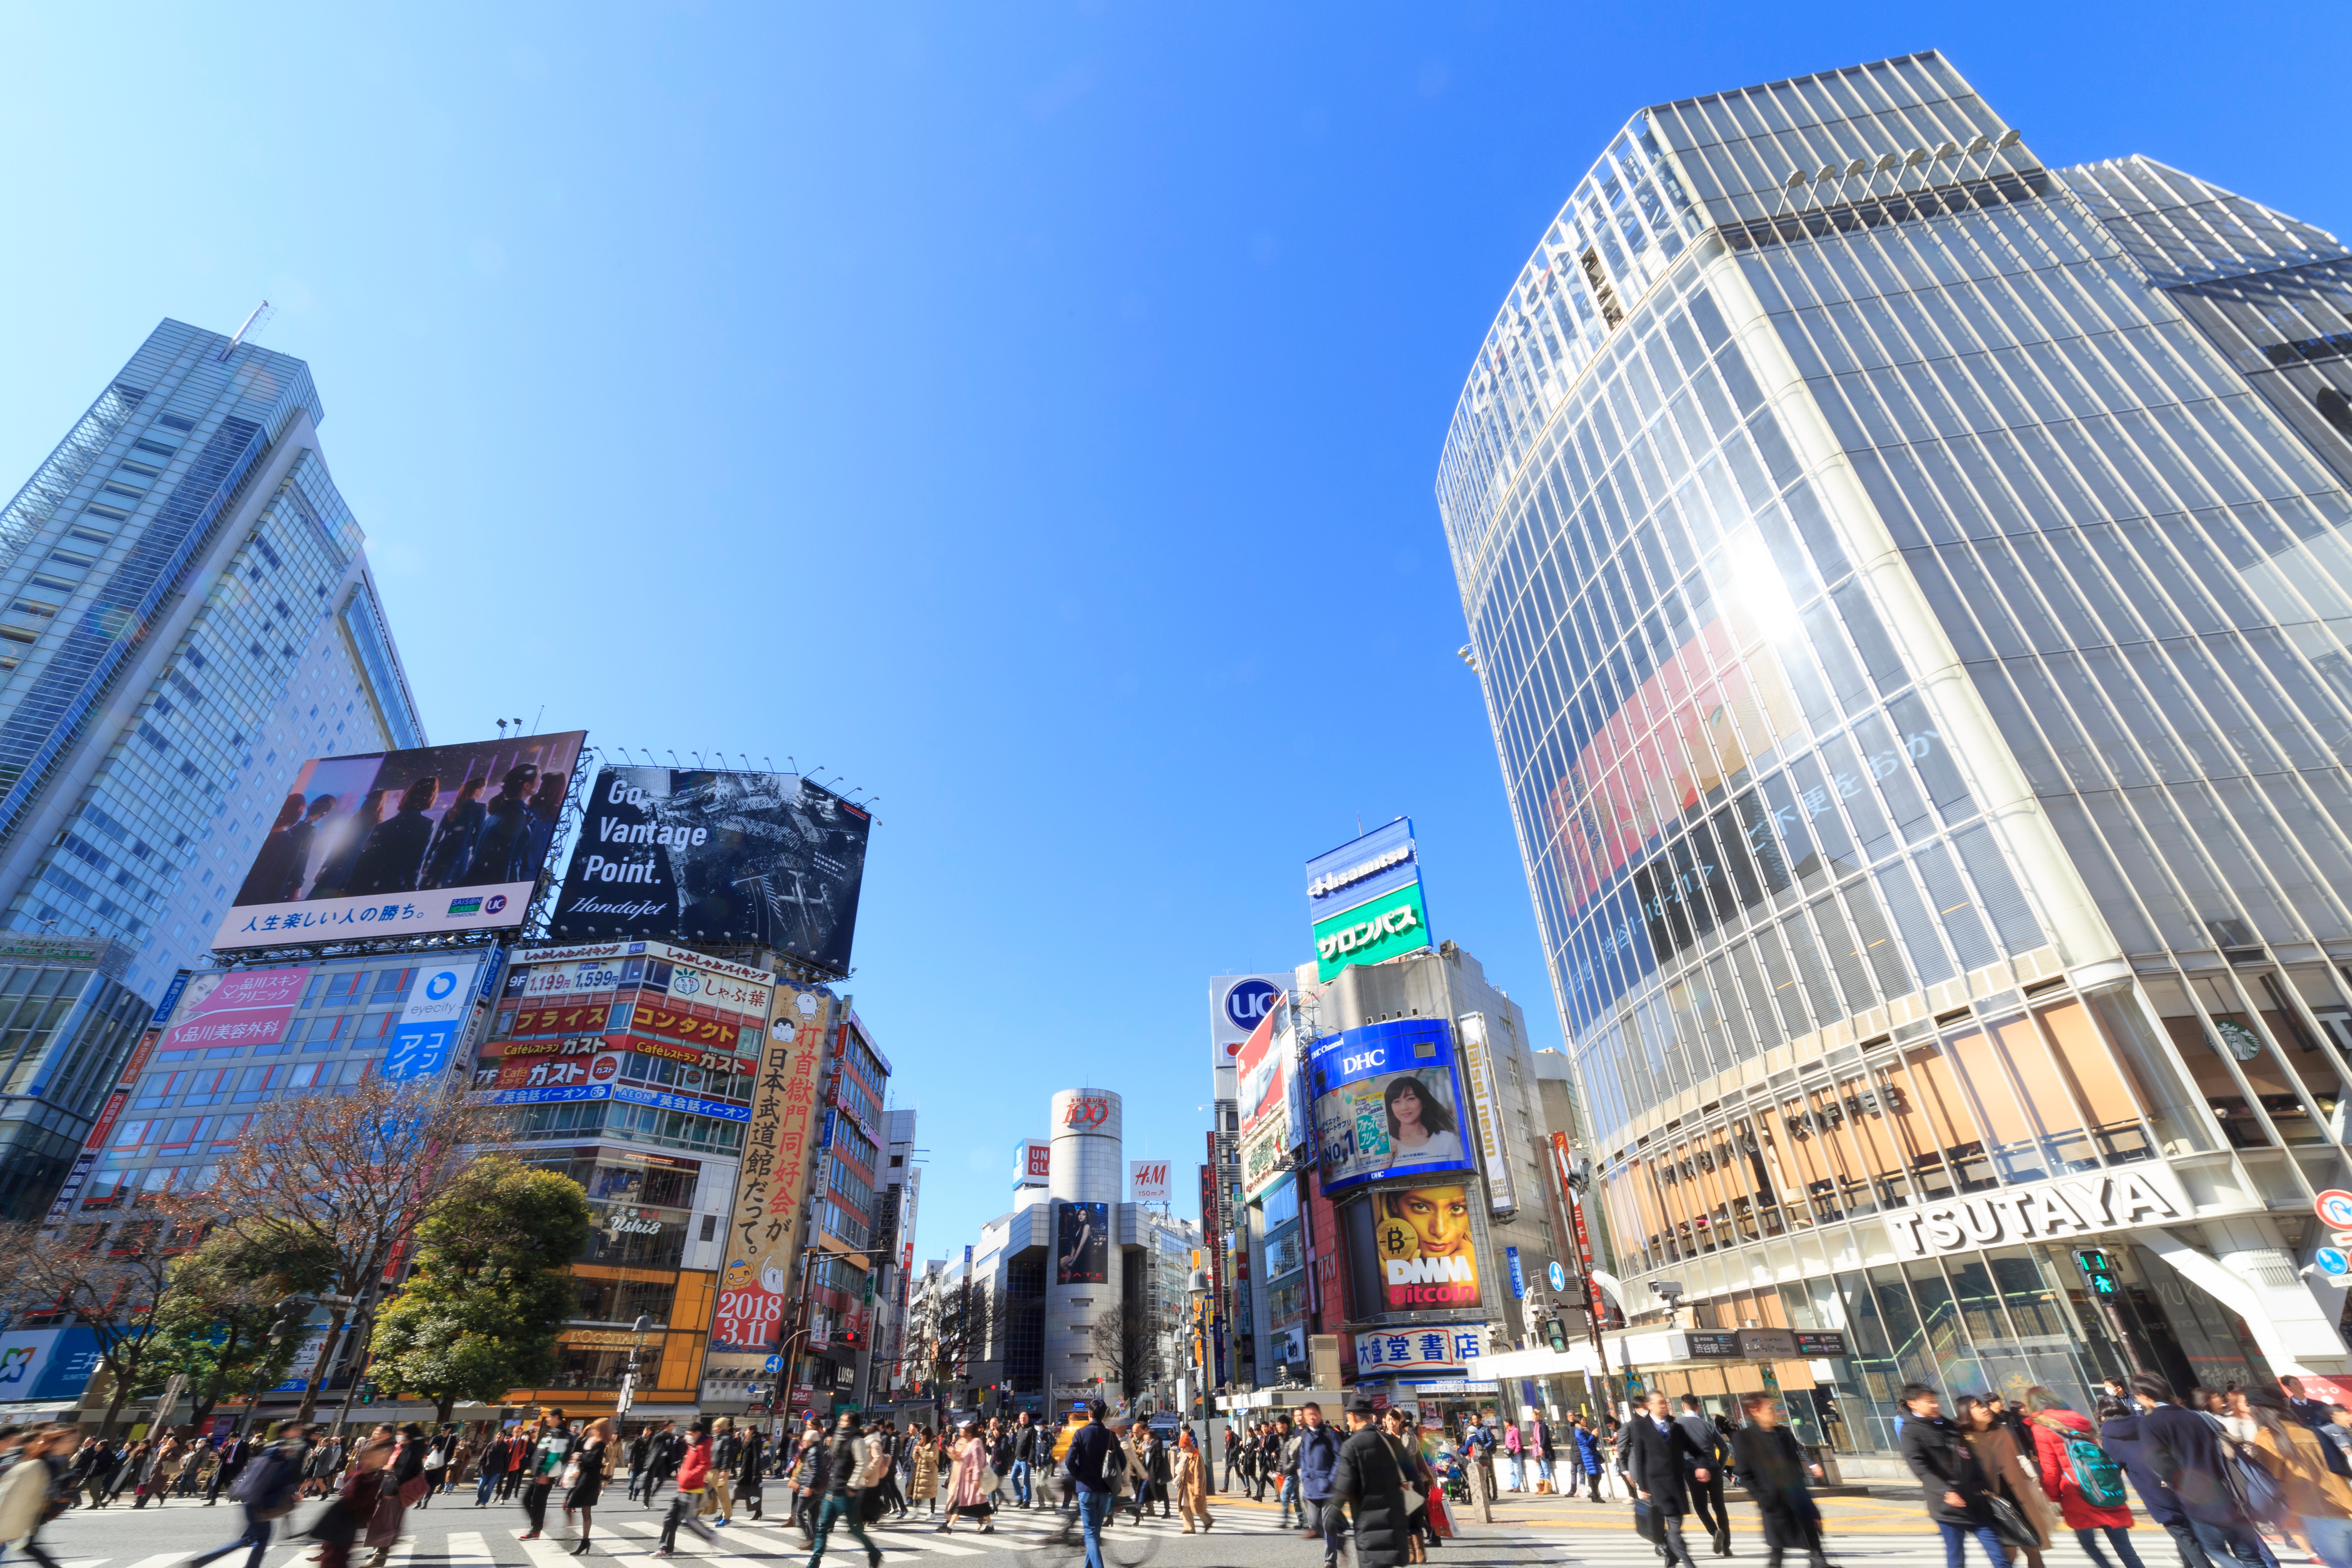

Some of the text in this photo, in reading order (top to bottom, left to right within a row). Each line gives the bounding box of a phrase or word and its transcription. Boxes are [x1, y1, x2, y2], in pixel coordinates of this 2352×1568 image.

[608, 779, 642, 805] Go
[600, 816, 707, 852] Vantage
[583, 854, 661, 884] Point.
[1306, 845, 1409, 896] Hisamitsu
[240, 902, 424, 934] 人生楽しい人の勝ち。
[567, 896, 668, 921] HondaJet
[1317, 904, 1417, 960] サロンパス
[524, 944, 621, 961] しゃぶしゃぶバイキング
[667, 947, 770, 981] しゃぶしゃぶバイキング
[241, 975, 302, 989] 品川スキン
[508, 975, 527, 987] 9F
[576, 970, 618, 990] 1,599円
[229, 989, 290, 1003] クリニック
[706, 978, 766, 1007] しゃぶ葉
[411, 1002, 457, 1015] eyecity
[517, 1008, 606, 1030] プライス
[182, 1022, 279, 1042] 品川美容外科
[634, 1007, 736, 1043] コンタクト
[560, 1037, 606, 1055] ガスト
[1311, 1037, 1344, 1060] DHC Channel
[503, 1067, 528, 1078] Café
[699, 1052, 747, 1075] ガスト
[1343, 1049, 1386, 1075] DHC
[527, 1063, 585, 1086] ガスト
[503, 1087, 586, 1103] 英会話イーオン
[621, 1088, 652, 1103] AEON
[659, 1094, 749, 1119] 英会話イーオン
[1062, 1102, 1109, 1129] 109
[766, 1022, 823, 1242] 打首獄門同好会が
[1360, 1131, 1376, 1146] コリー
[739, 1048, 788, 1255] 日本武道館だって。
[817, 1158, 828, 1194] 渋谷駅前ビル
[1135, 1164, 1166, 1186] H&M
[1371, 1170, 1384, 1179] DHC
[1889, 1171, 2175, 1253] TSUTAYA
[1386, 1256, 1474, 1285] DMM
[1389, 1282, 1475, 1304] Bitcoin
[720, 1292, 783, 1321] 2018
[720, 1318, 768, 1345] 3.11
[1360, 1333, 1480, 1367] 大盛堂書店
[1695, 1343, 1720, 1353] 渋谷駅
[837, 1366, 854, 1385] LUSH
